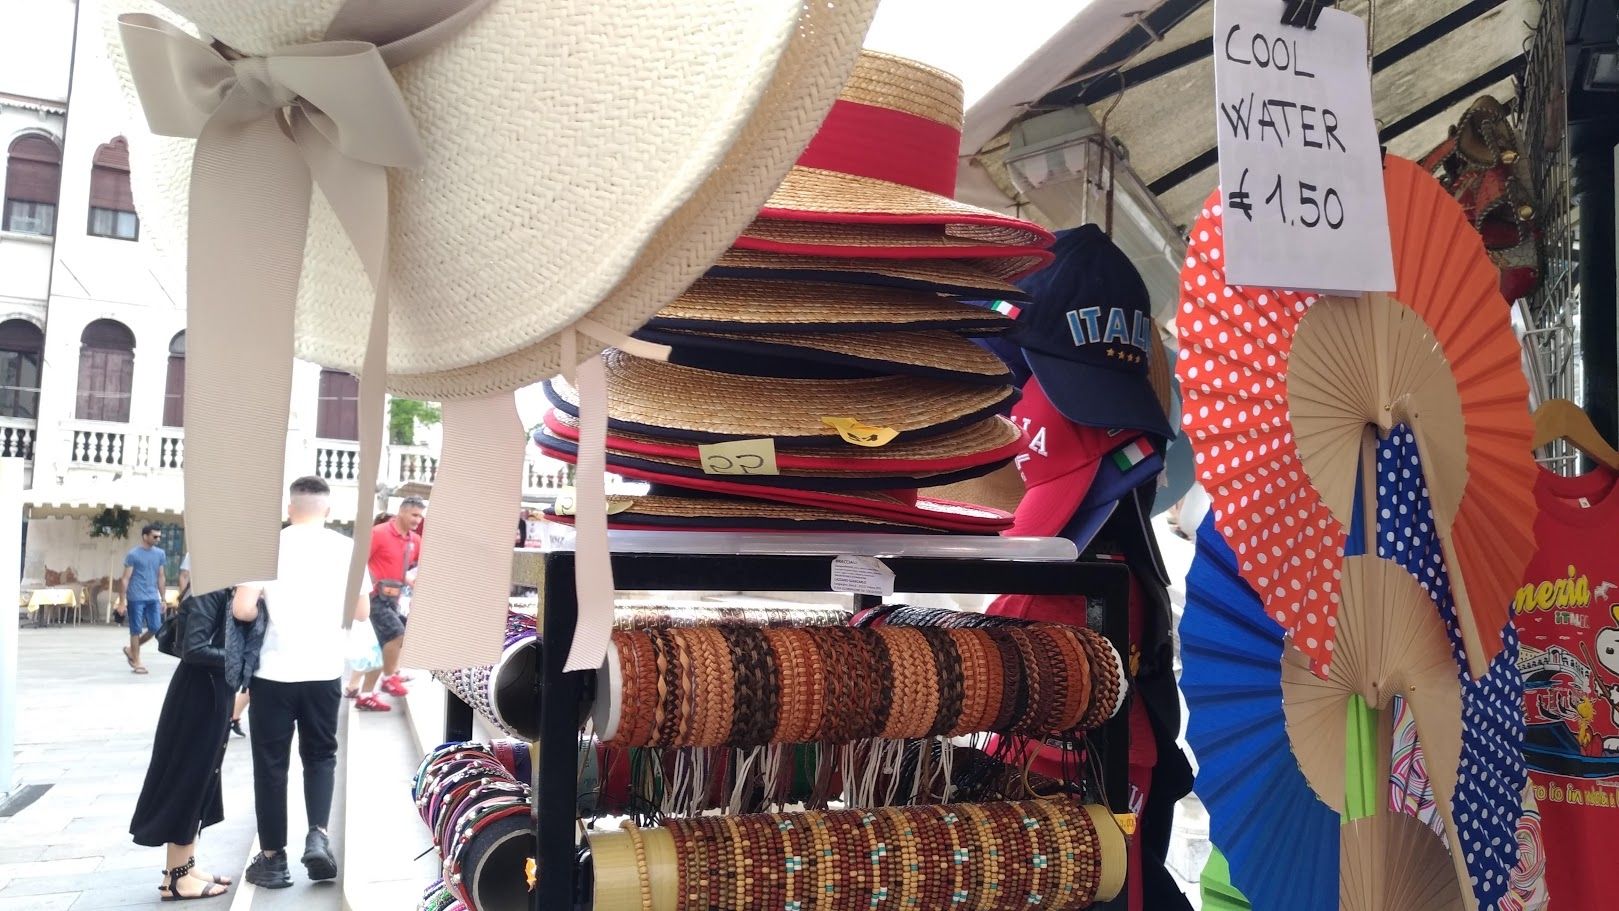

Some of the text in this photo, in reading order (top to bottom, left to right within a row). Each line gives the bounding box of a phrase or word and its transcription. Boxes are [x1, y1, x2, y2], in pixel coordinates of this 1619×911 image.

[1225, 24, 1315, 78] COOL
[1221, 93, 1346, 153] WATER
[1265, 174, 1344, 229] 1.50
[1514, 564, 1591, 616] nezia
